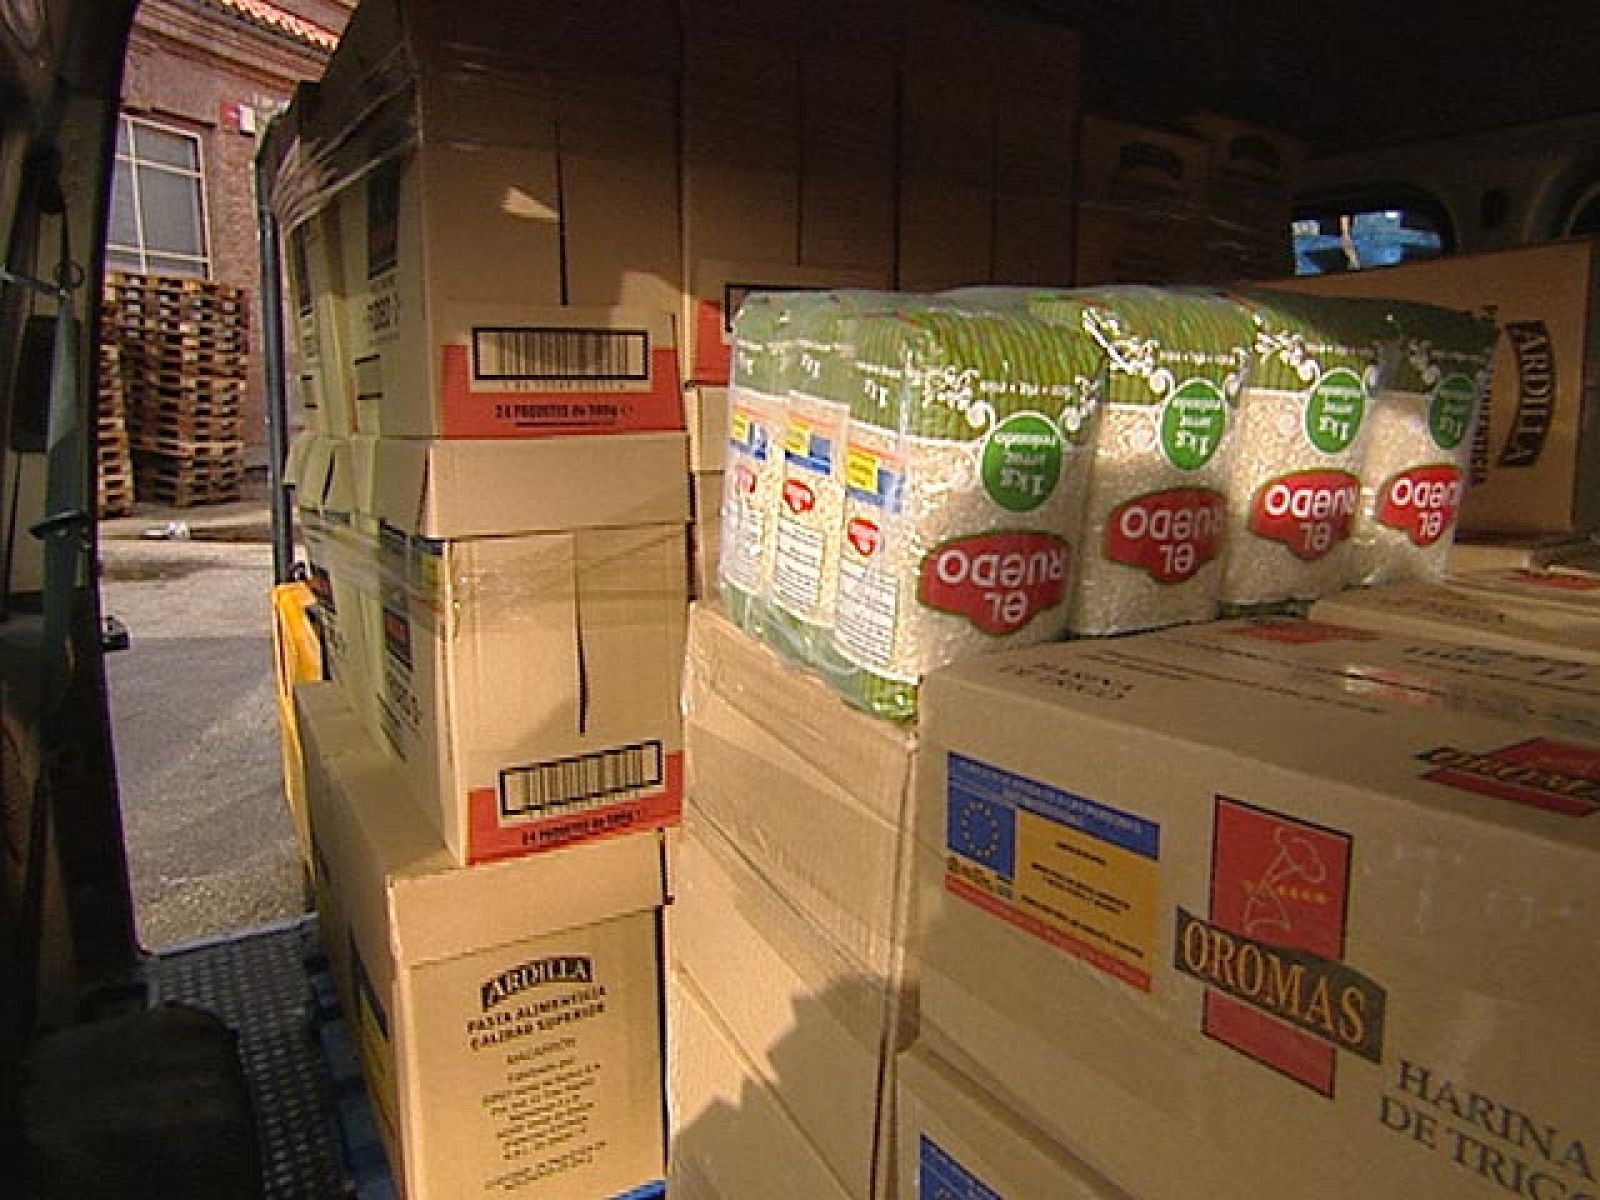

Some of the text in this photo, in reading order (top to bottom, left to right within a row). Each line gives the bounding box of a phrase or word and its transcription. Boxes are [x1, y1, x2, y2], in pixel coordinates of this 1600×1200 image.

[1504, 325, 1551, 464] ARDILLA
[1183, 920, 1366, 1044] OROMAS
[1379, 1094, 1598, 1200] DE TRIG
[1400, 1059, 1598, 1183] HARINA
